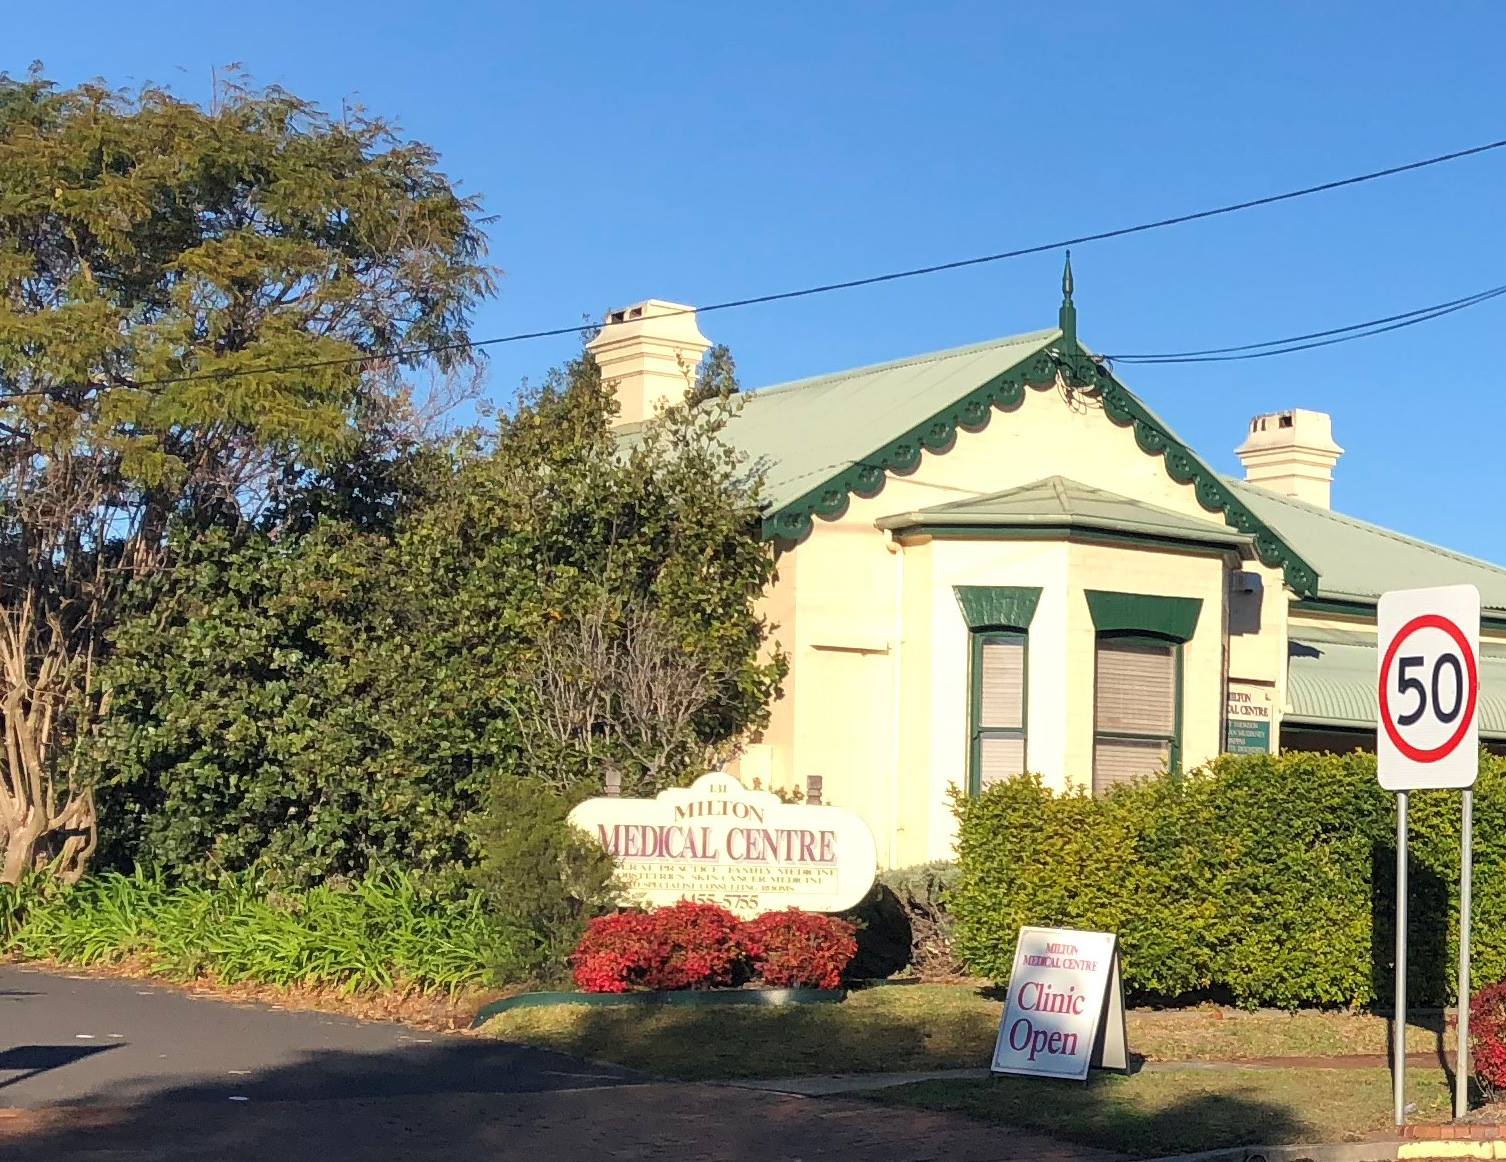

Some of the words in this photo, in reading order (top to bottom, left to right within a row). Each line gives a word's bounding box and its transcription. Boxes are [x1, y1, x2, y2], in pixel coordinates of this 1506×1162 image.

[1397, 653, 1463, 726] 50
[1240, 705, 1269, 717] CENTRE
[674, 800, 765, 824] MILTON
[597, 823, 718, 860] MEDICAL
[725, 827, 837, 864] CENTRE
[1022, 955, 1061, 969] MEDICAL
[1063, 958, 1098, 972] CENTRE
[1045, 942, 1079, 956] MILTON
[1018, 981, 1087, 1016] Clinic
[1009, 1018, 1079, 1061] Open
